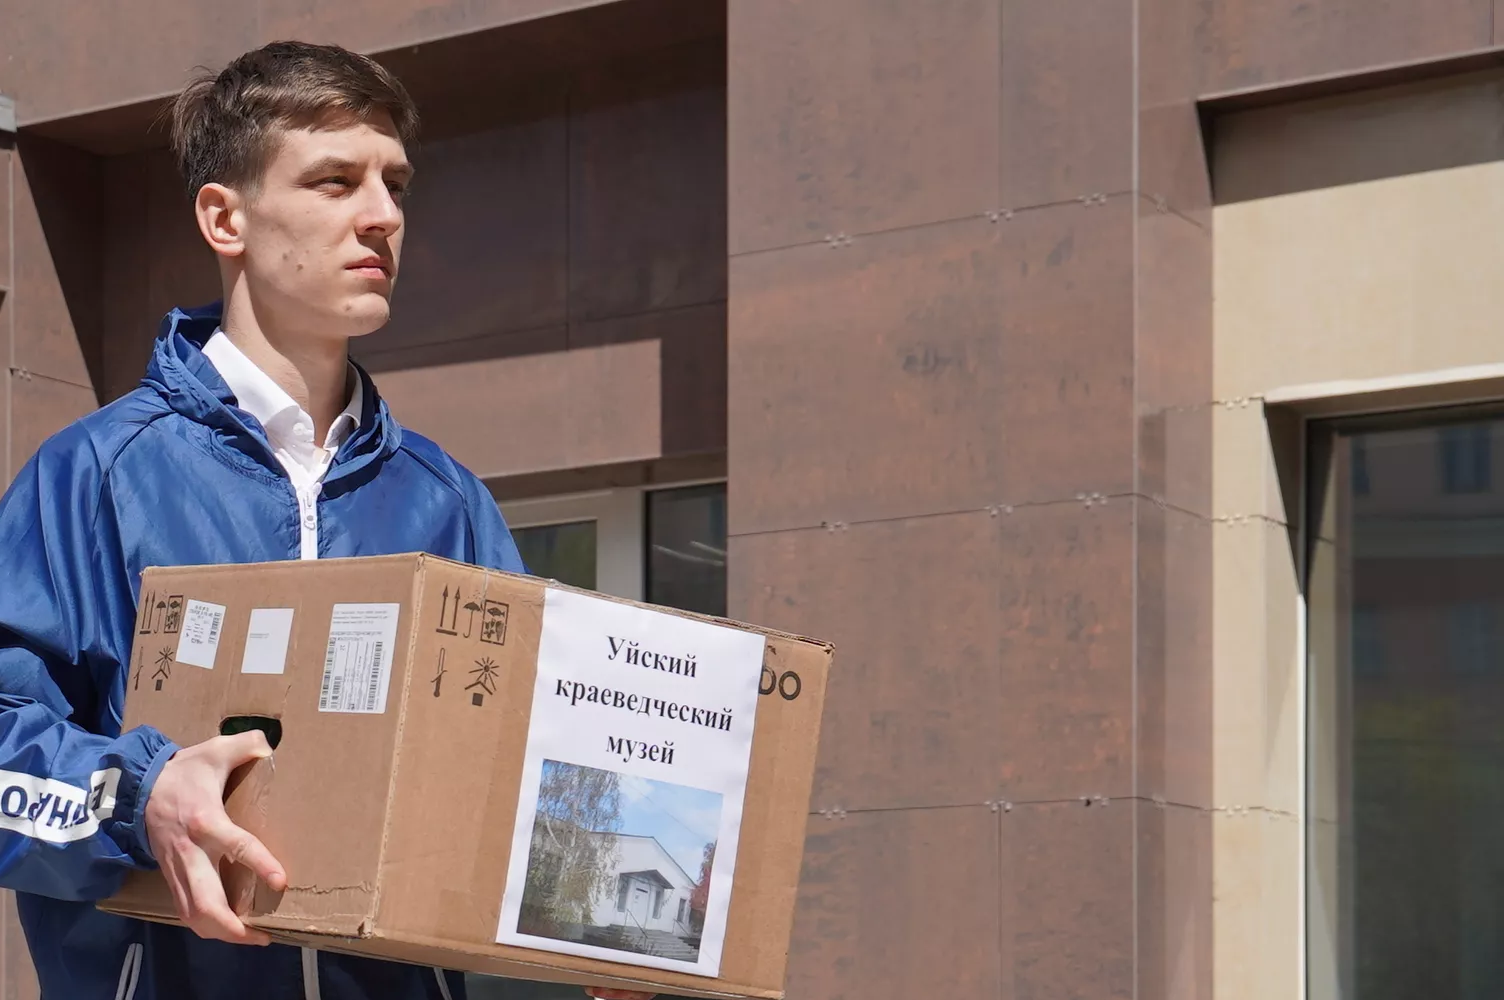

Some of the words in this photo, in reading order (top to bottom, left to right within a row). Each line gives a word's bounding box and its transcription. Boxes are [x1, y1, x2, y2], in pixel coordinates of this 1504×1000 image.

[606, 635, 697, 678] Уйский
[555, 678, 733, 732] краеведческий
[606, 735, 675, 765] музей
